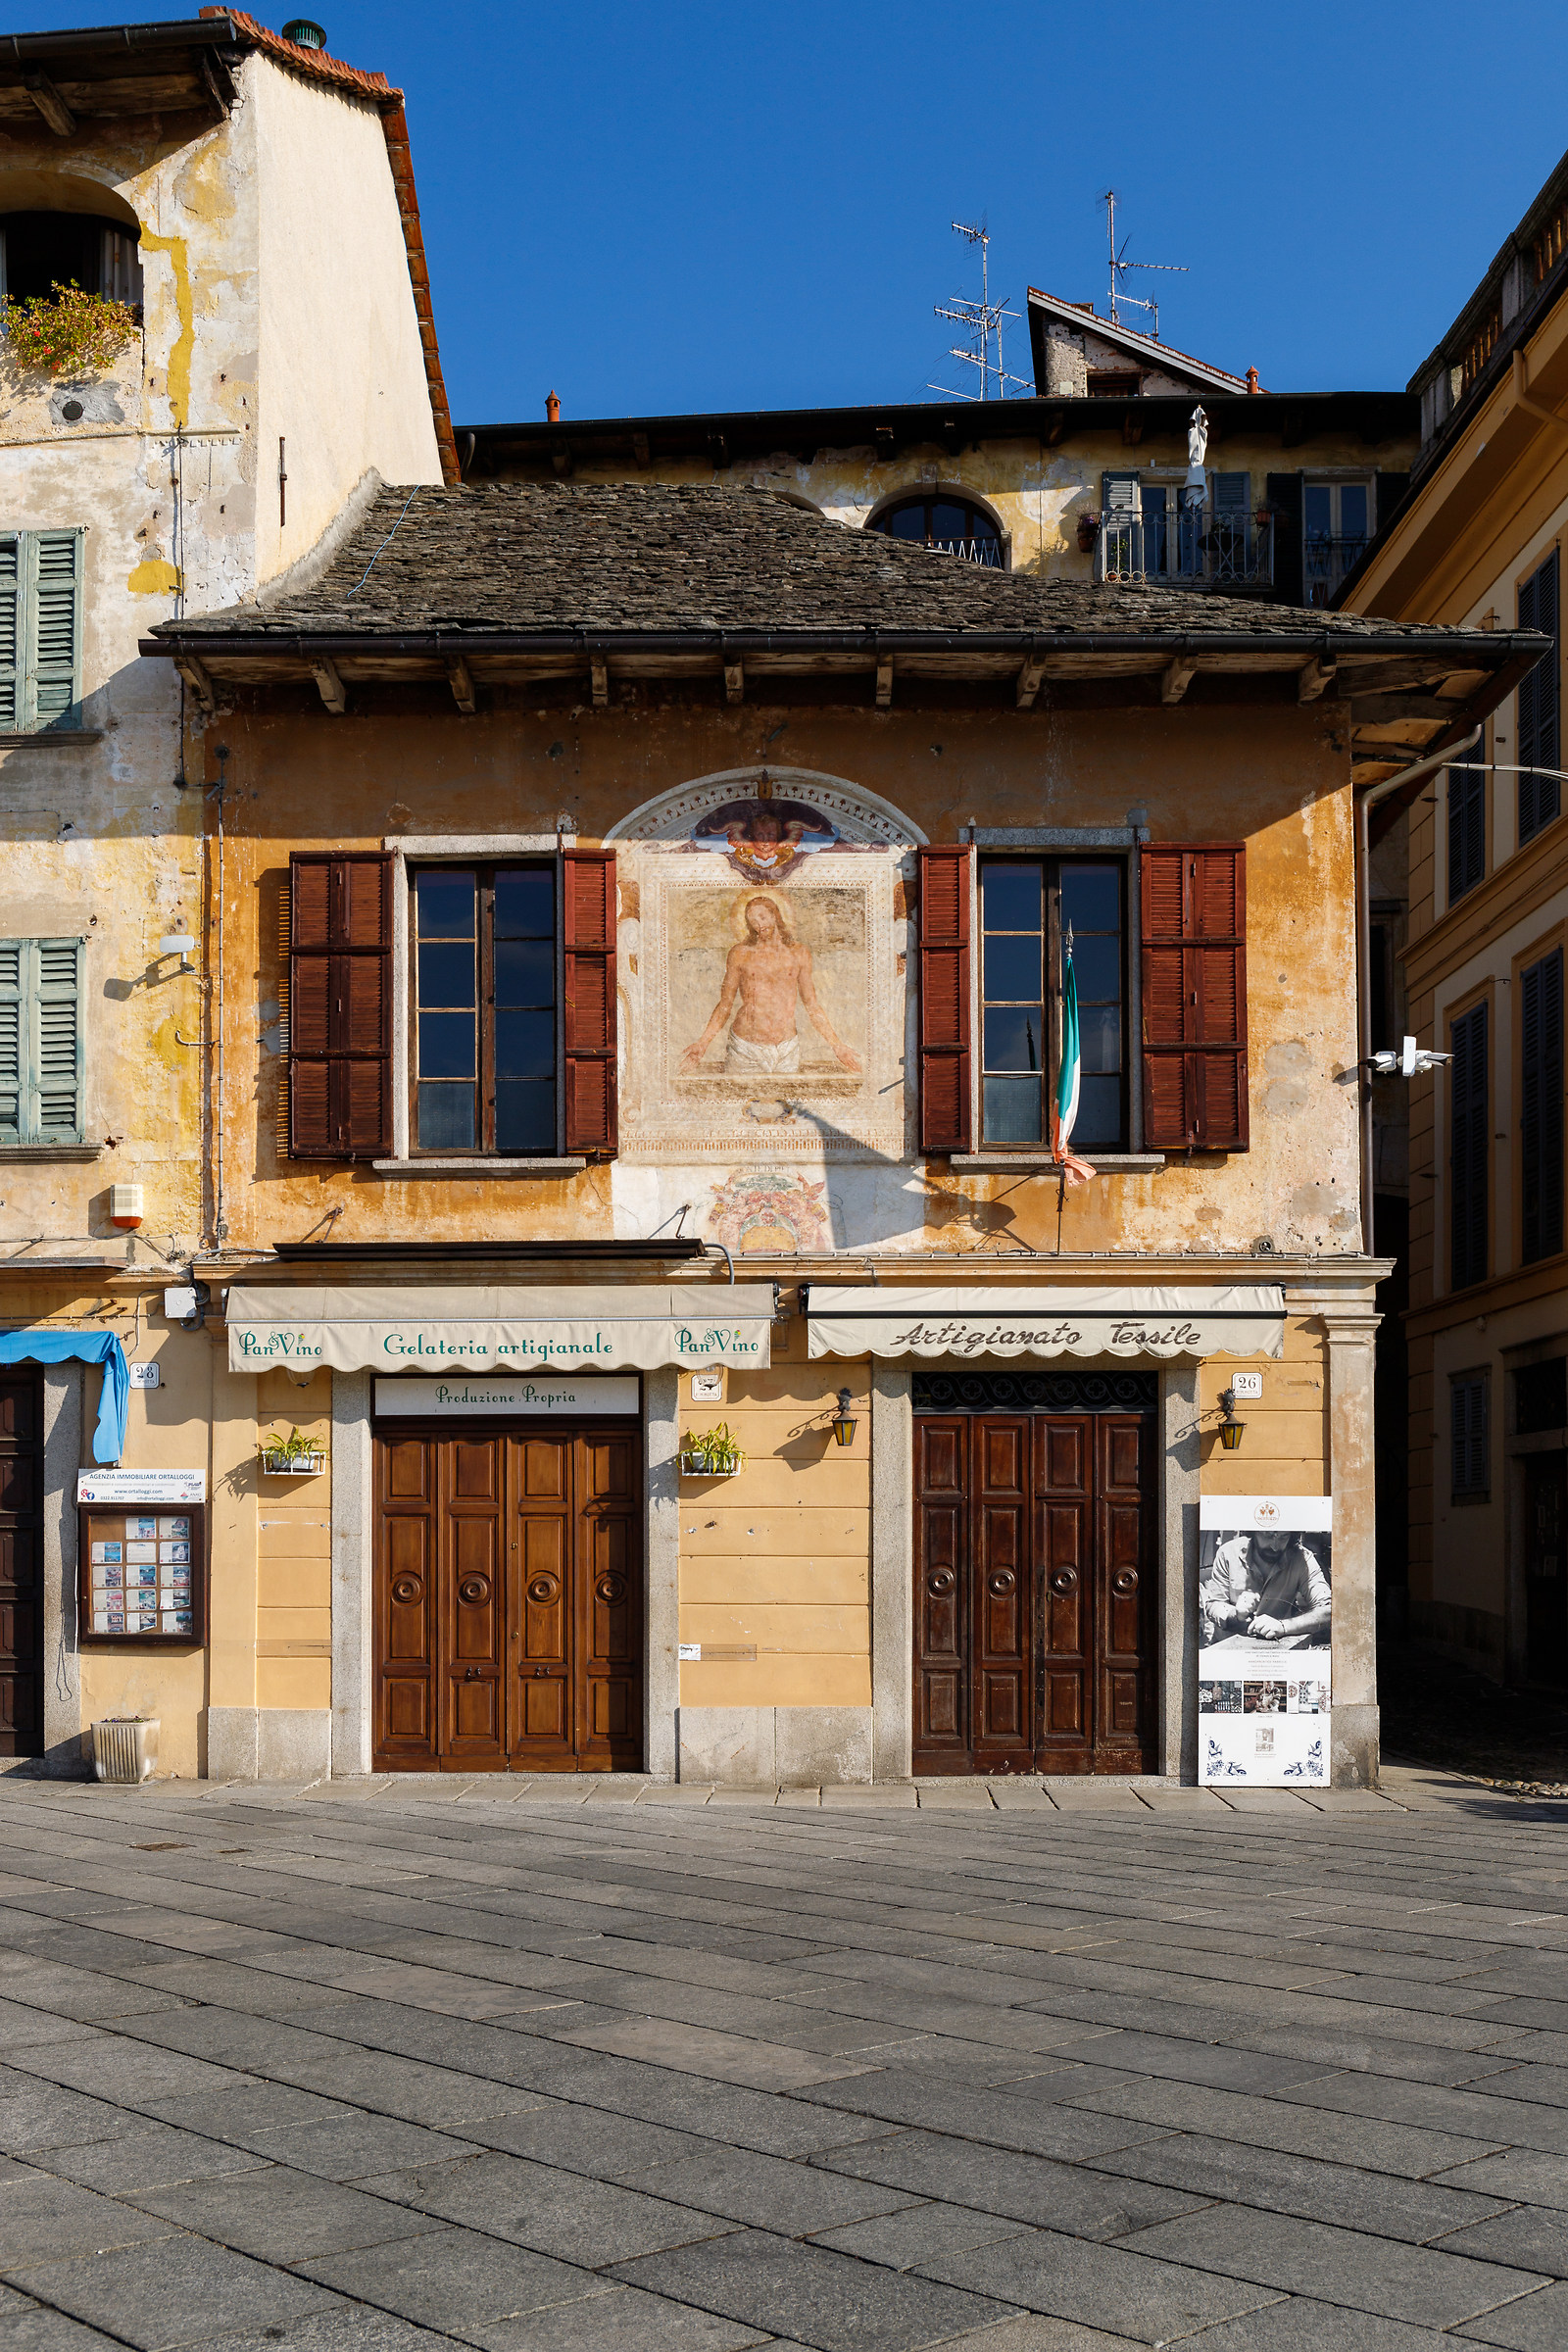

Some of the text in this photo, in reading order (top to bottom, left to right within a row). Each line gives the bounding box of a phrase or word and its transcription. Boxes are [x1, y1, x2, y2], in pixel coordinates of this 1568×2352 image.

[383, 1332, 613, 1362] Gelateria artigianale
[889, 1321, 1201, 1353] Artigianato Tessile
[135, 1365, 154, 1379] 28
[1238, 1376, 1257, 1389] 26
[435, 1383, 576, 1408] Produzione Propria
